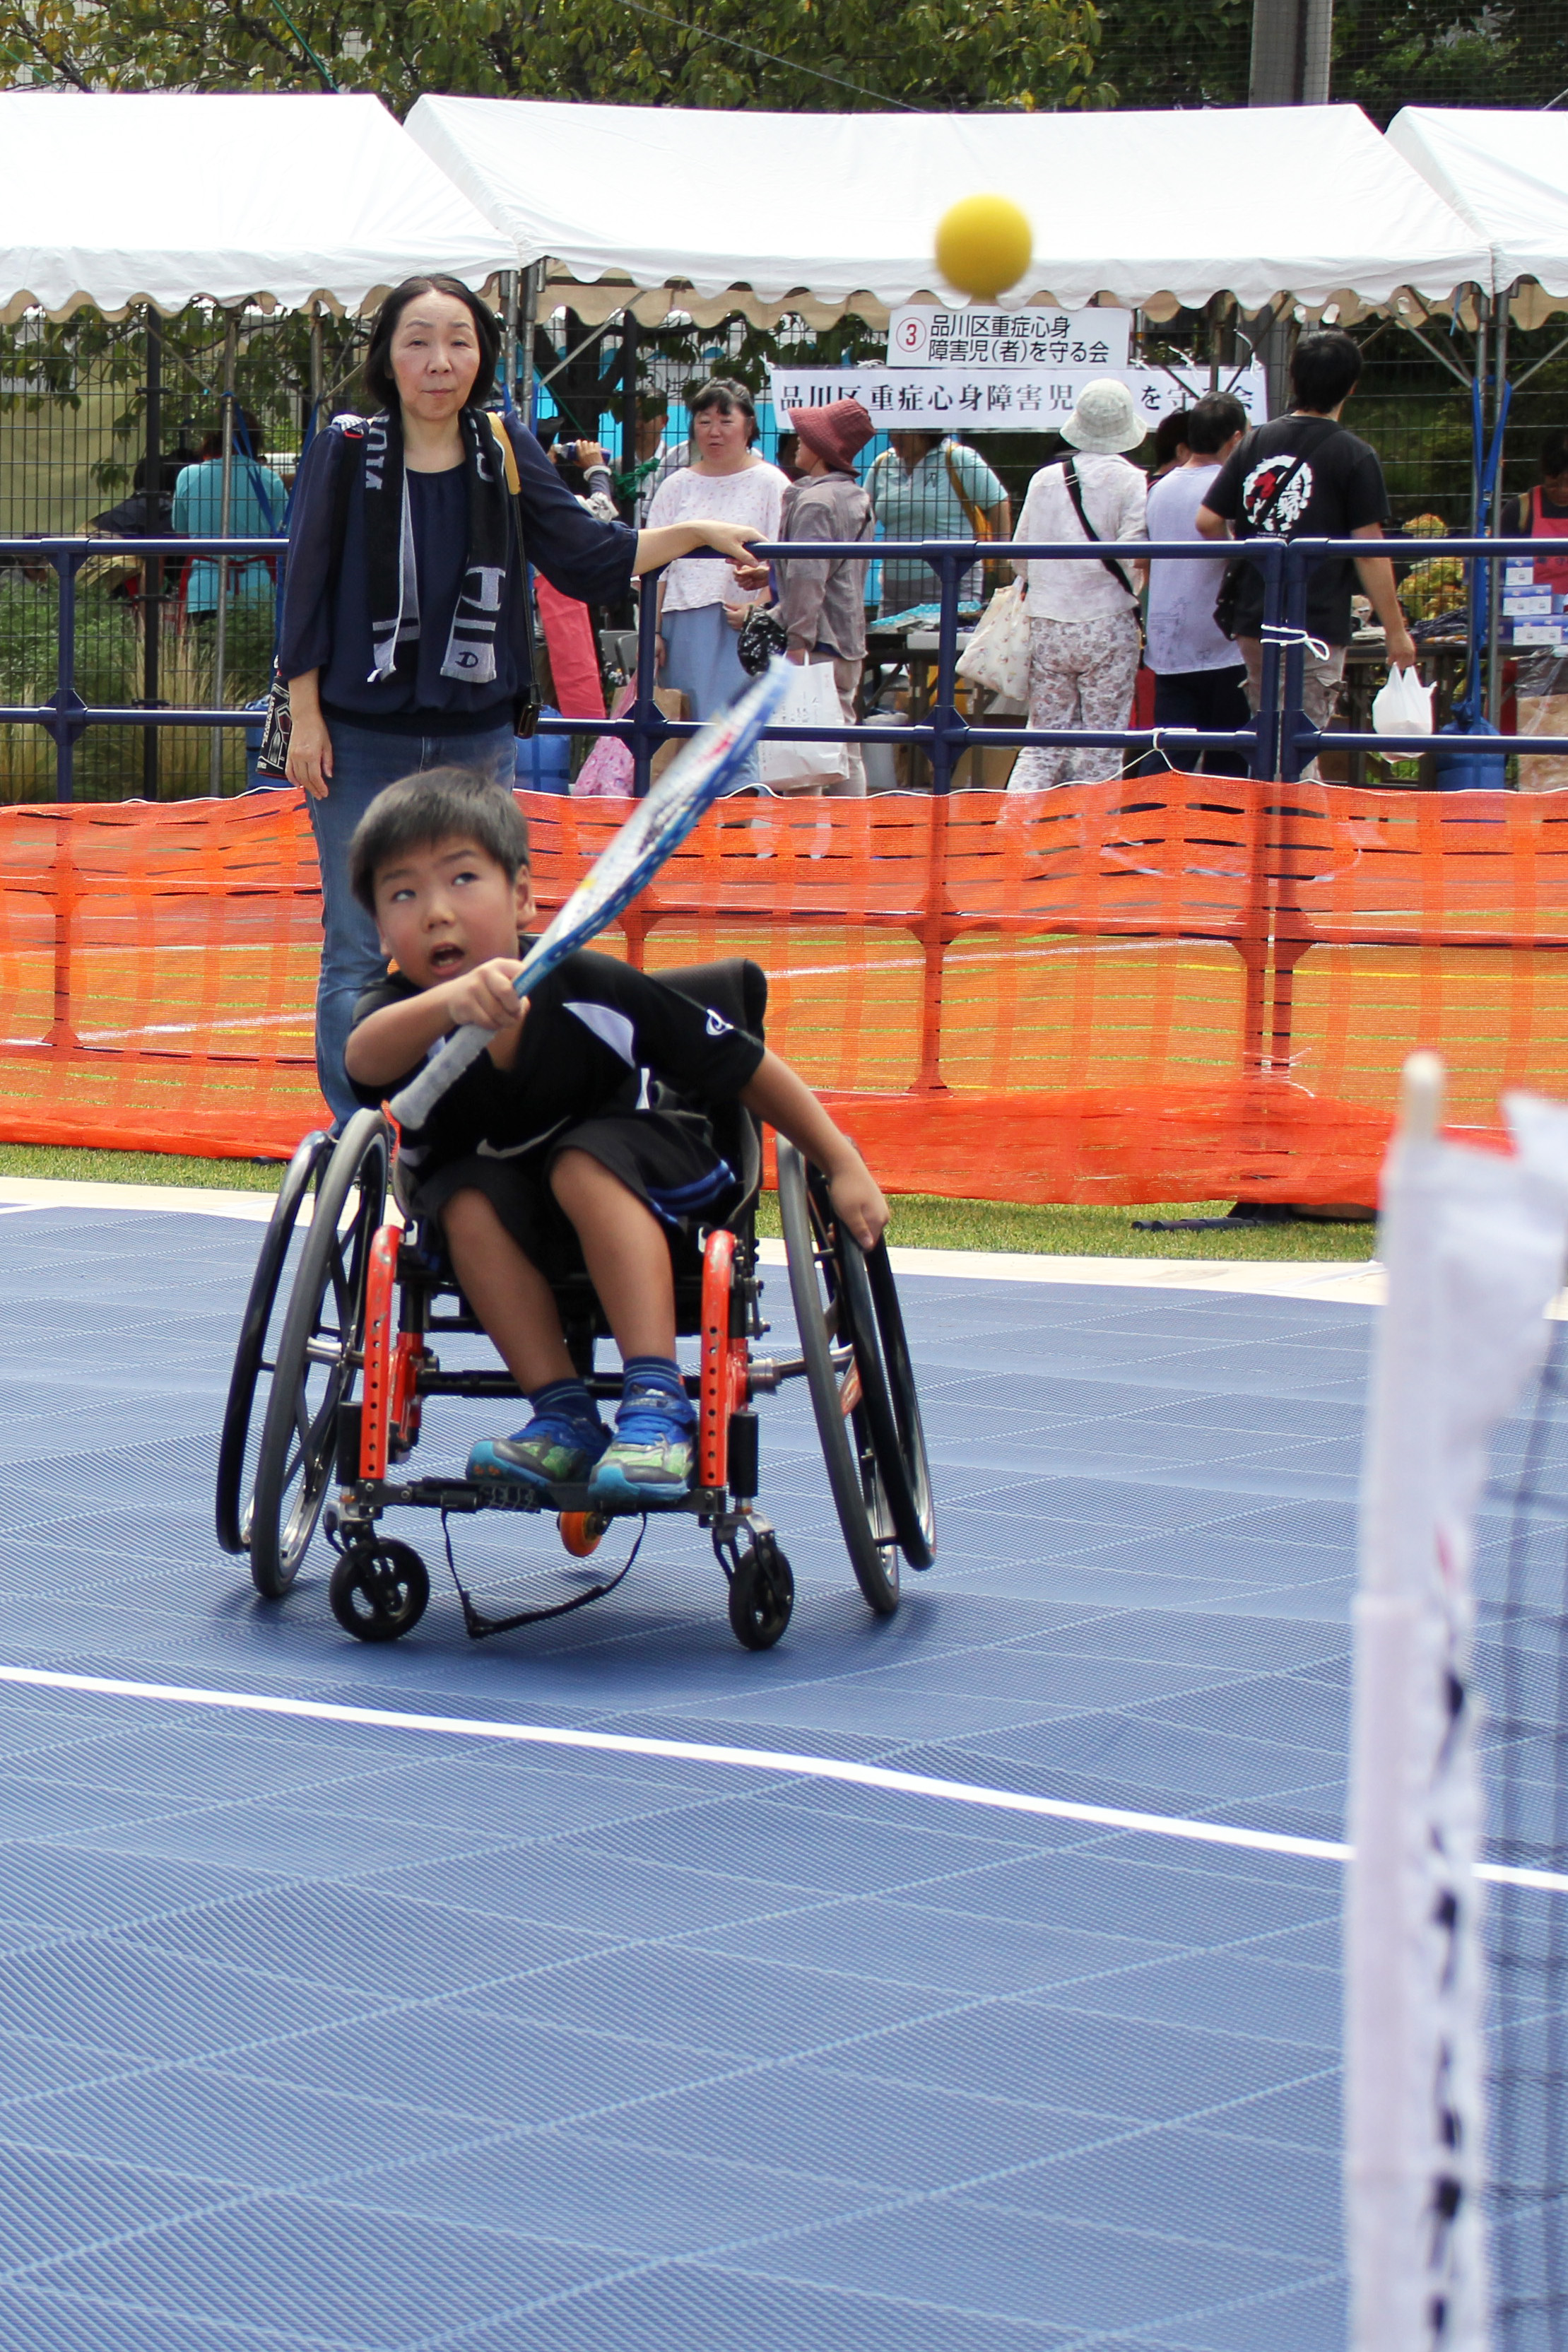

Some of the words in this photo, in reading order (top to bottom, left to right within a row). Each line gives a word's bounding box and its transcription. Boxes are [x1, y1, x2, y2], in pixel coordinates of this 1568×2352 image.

[930, 314, 1071, 339] 品川区重症心身
[929, 339, 1109, 362] 障害児(者)を守る会
